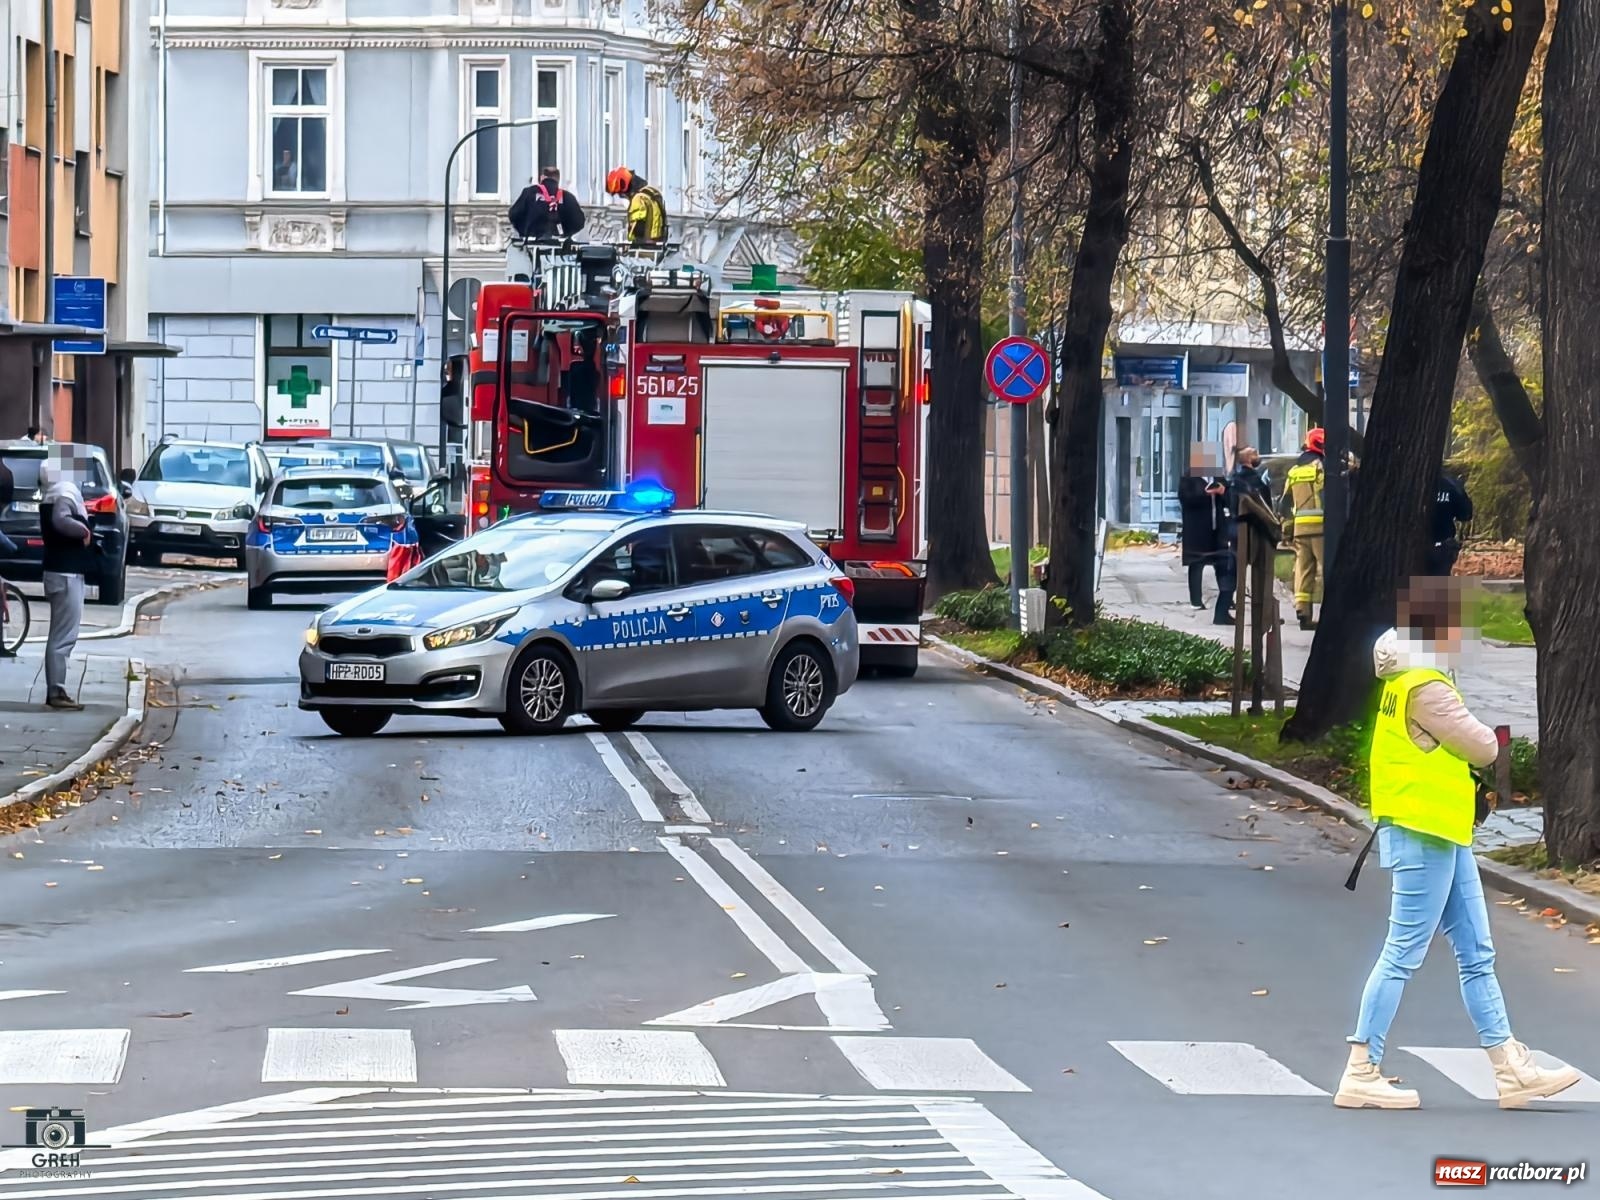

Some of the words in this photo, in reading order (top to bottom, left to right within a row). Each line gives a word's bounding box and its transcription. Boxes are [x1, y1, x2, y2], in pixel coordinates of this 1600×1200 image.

[637, 376, 665, 395] 561
[677, 376, 698, 395] 25
[613, 617, 667, 639] POLICJA
